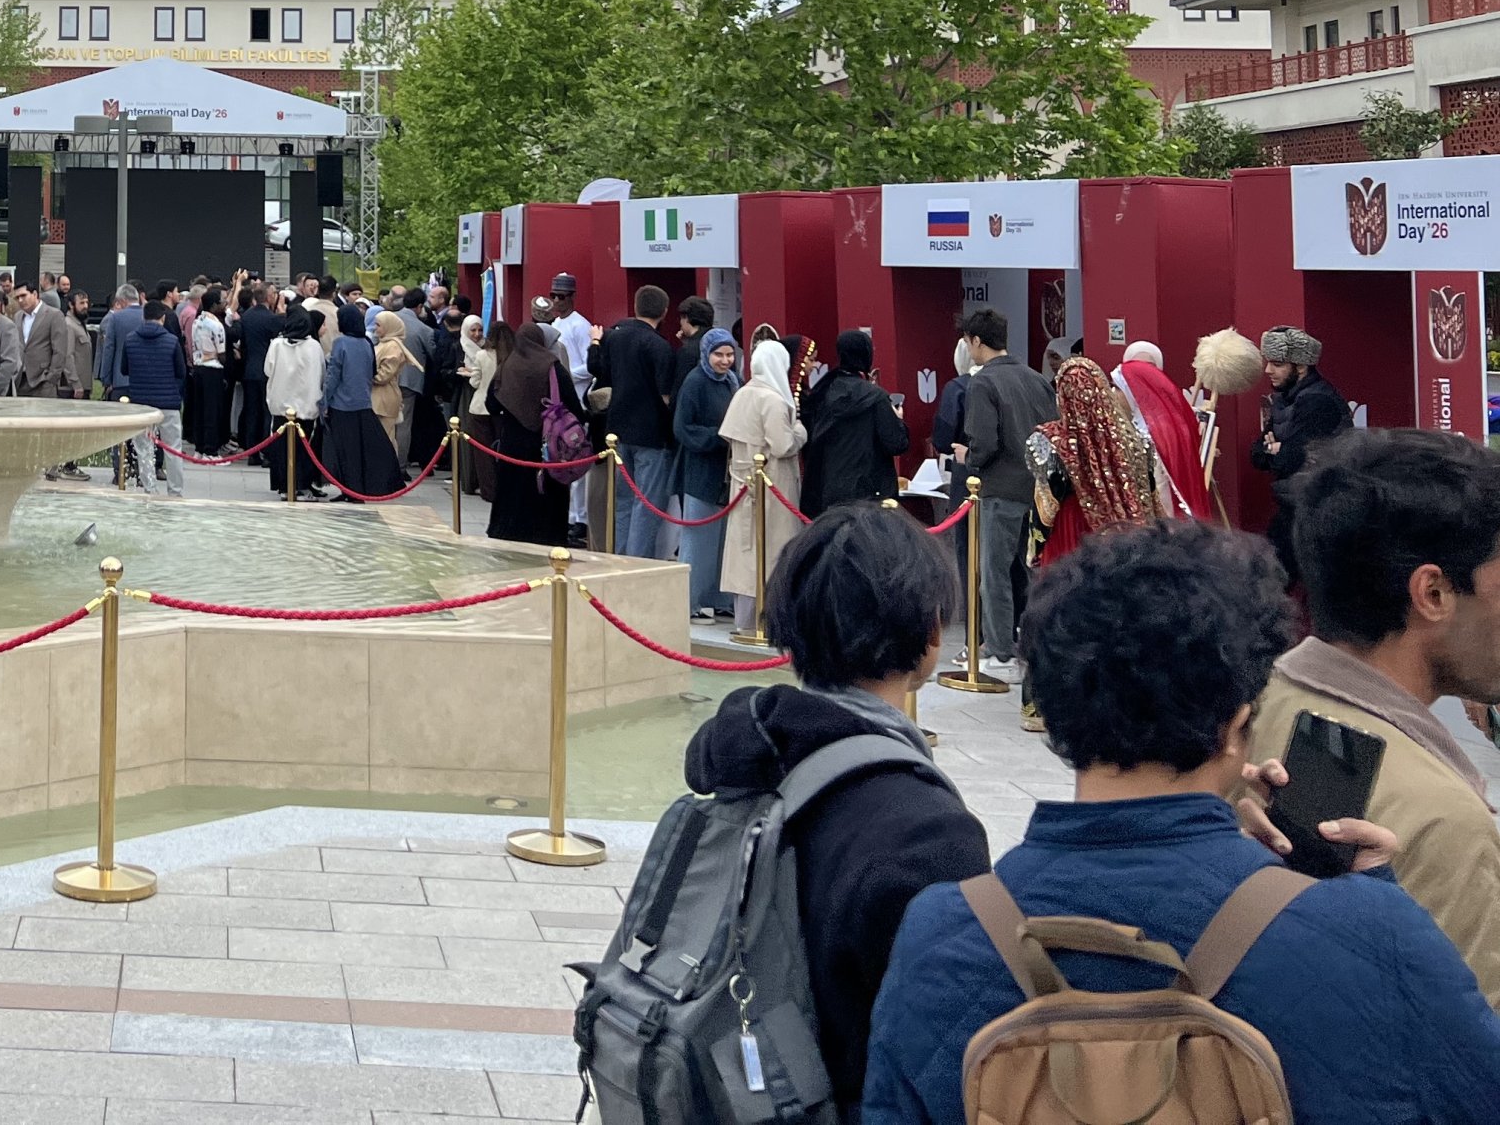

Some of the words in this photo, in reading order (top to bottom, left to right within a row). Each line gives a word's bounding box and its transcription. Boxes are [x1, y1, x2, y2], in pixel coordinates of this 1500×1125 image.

[81, 47, 101, 62] VE
[104, 47, 165, 62] TOPLUM
[171, 46, 244, 63] BİLİMLERİ
[248, 47, 332, 63] FAKÜLTESİ
[124, 107, 189, 118] International
[191, 108, 212, 120] Day
[212, 109, 228, 118] '26
[1397, 200, 1490, 220] International
[1398, 223, 1426, 244] Day
[1427, 222, 1449, 239] '26
[648, 243, 672, 253] NIGERIA
[929, 240, 964, 251] RUSSIA
